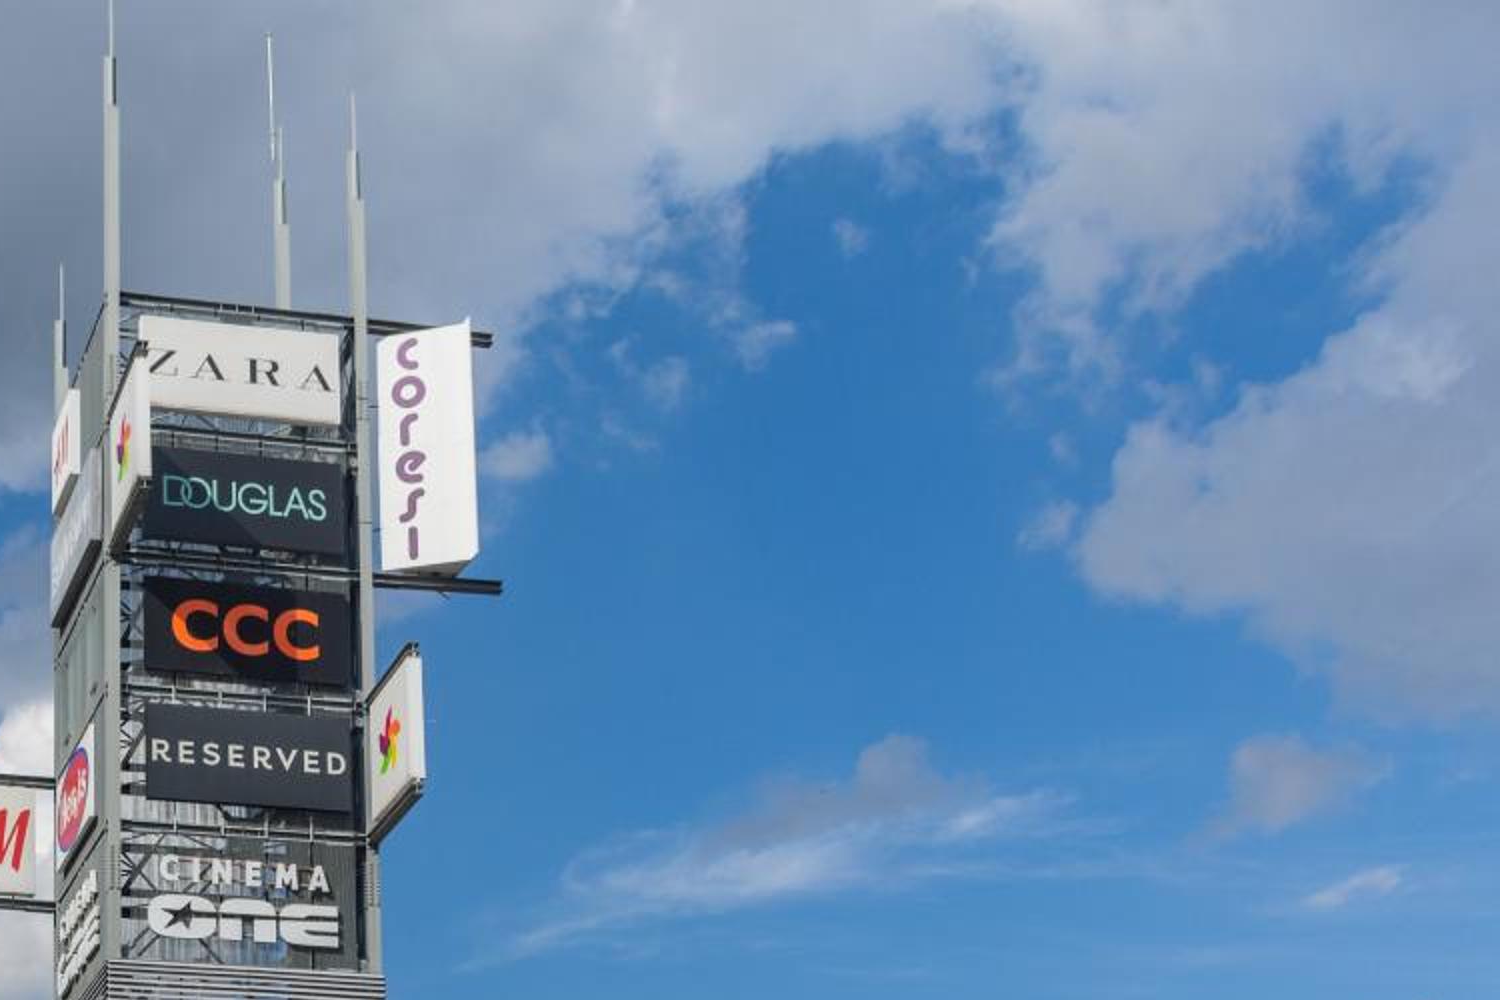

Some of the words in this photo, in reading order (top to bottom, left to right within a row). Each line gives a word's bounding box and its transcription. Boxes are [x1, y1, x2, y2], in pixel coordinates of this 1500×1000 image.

[148, 347, 337, 393] ZARA
[391, 337, 427, 561] coresi
[163, 474, 328, 522] DOUGLAS
[171, 598, 321, 662] CCC
[150, 737, 347, 776] RESERVED
[159, 854, 331, 894] CINEMA
